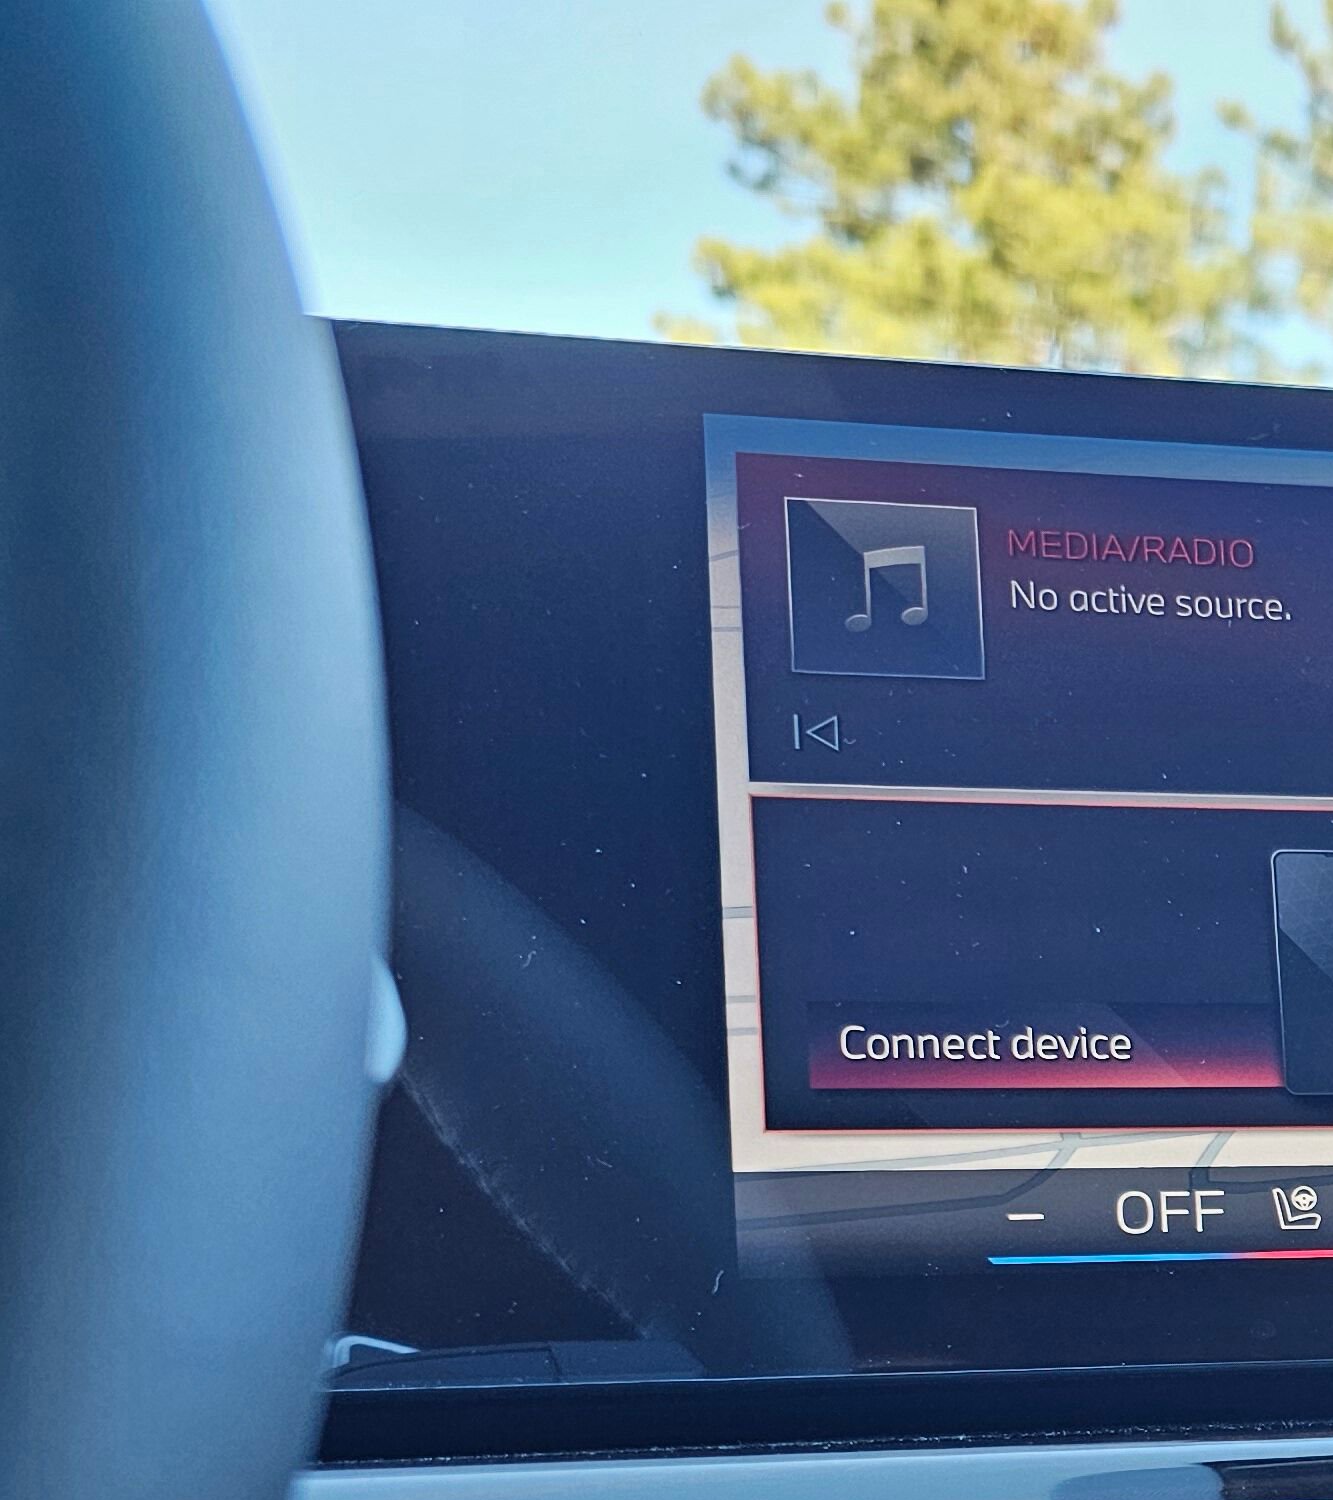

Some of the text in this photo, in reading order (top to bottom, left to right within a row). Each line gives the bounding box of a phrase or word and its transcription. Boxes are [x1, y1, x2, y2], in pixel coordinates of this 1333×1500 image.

[1007, 529, 1255, 569] MEDIA/RADIO
[1010, 580, 1294, 623] No active source.
[840, 1023, 1133, 1064] Connect device
[1116, 1189, 1226, 1235] OFF
